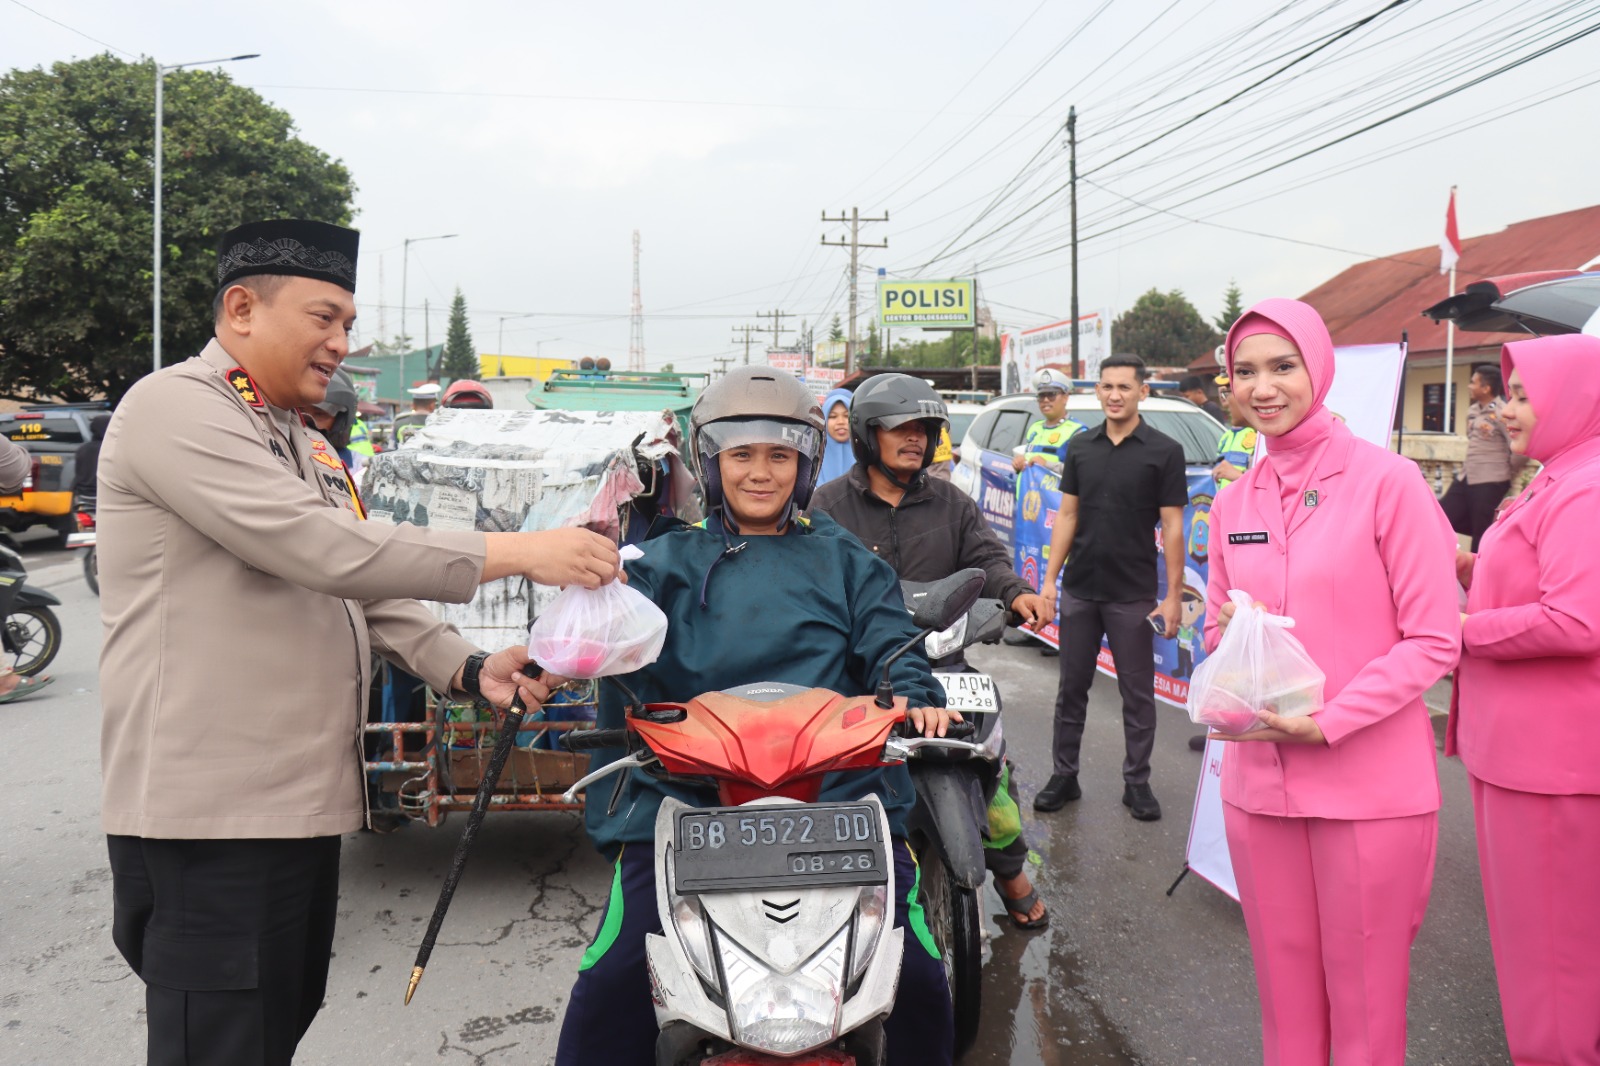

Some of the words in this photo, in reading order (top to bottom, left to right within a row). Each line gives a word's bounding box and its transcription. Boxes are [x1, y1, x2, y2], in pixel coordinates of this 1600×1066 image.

[886, 289, 963, 308] POLISI
[20, 423, 42, 433] 110
[983, 486, 1014, 518] POLISI
[959, 676, 991, 691] ADW
[689, 820, 726, 850] BB
[740, 815, 815, 846] 5522
[834, 813, 870, 842] DD
